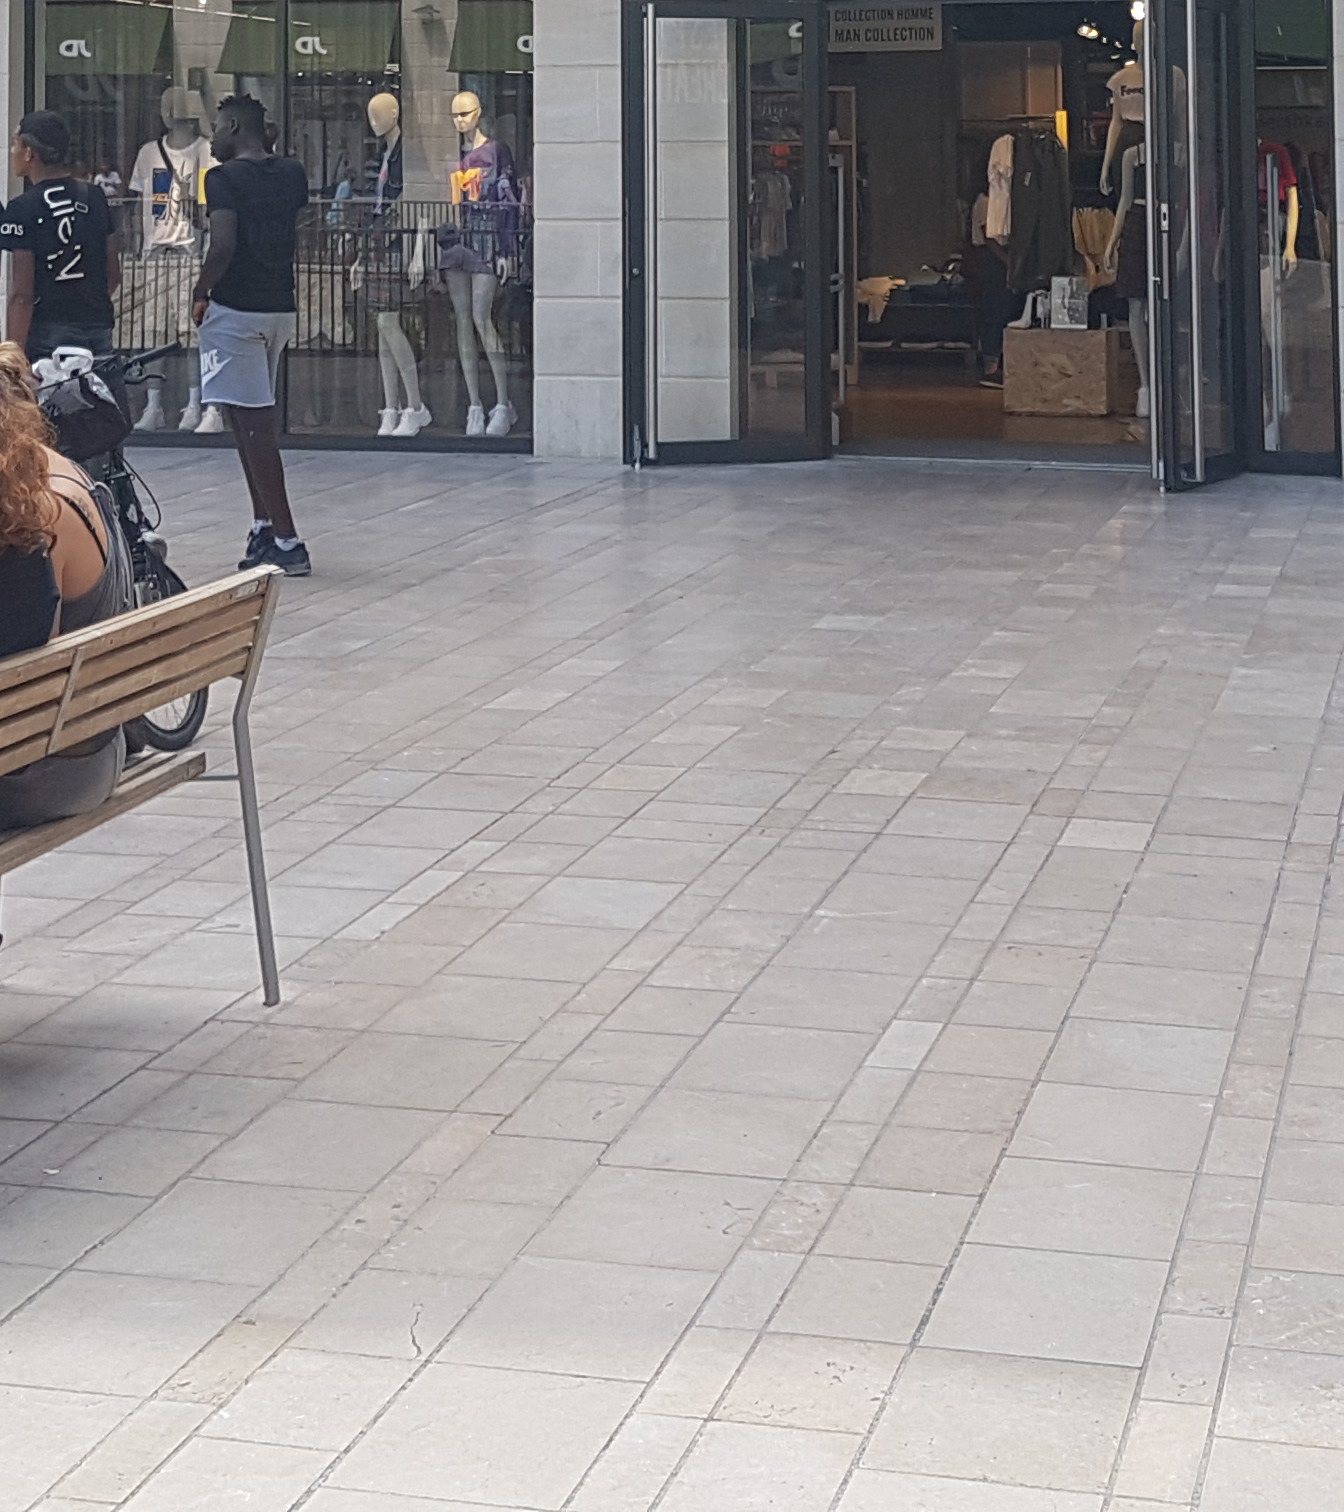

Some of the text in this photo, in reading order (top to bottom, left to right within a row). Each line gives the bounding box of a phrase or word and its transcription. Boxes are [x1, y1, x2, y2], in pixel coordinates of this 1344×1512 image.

[834, 7, 934, 22] COLLECTION HOMME
[834, 27, 935, 43] MAN COLLECTION
